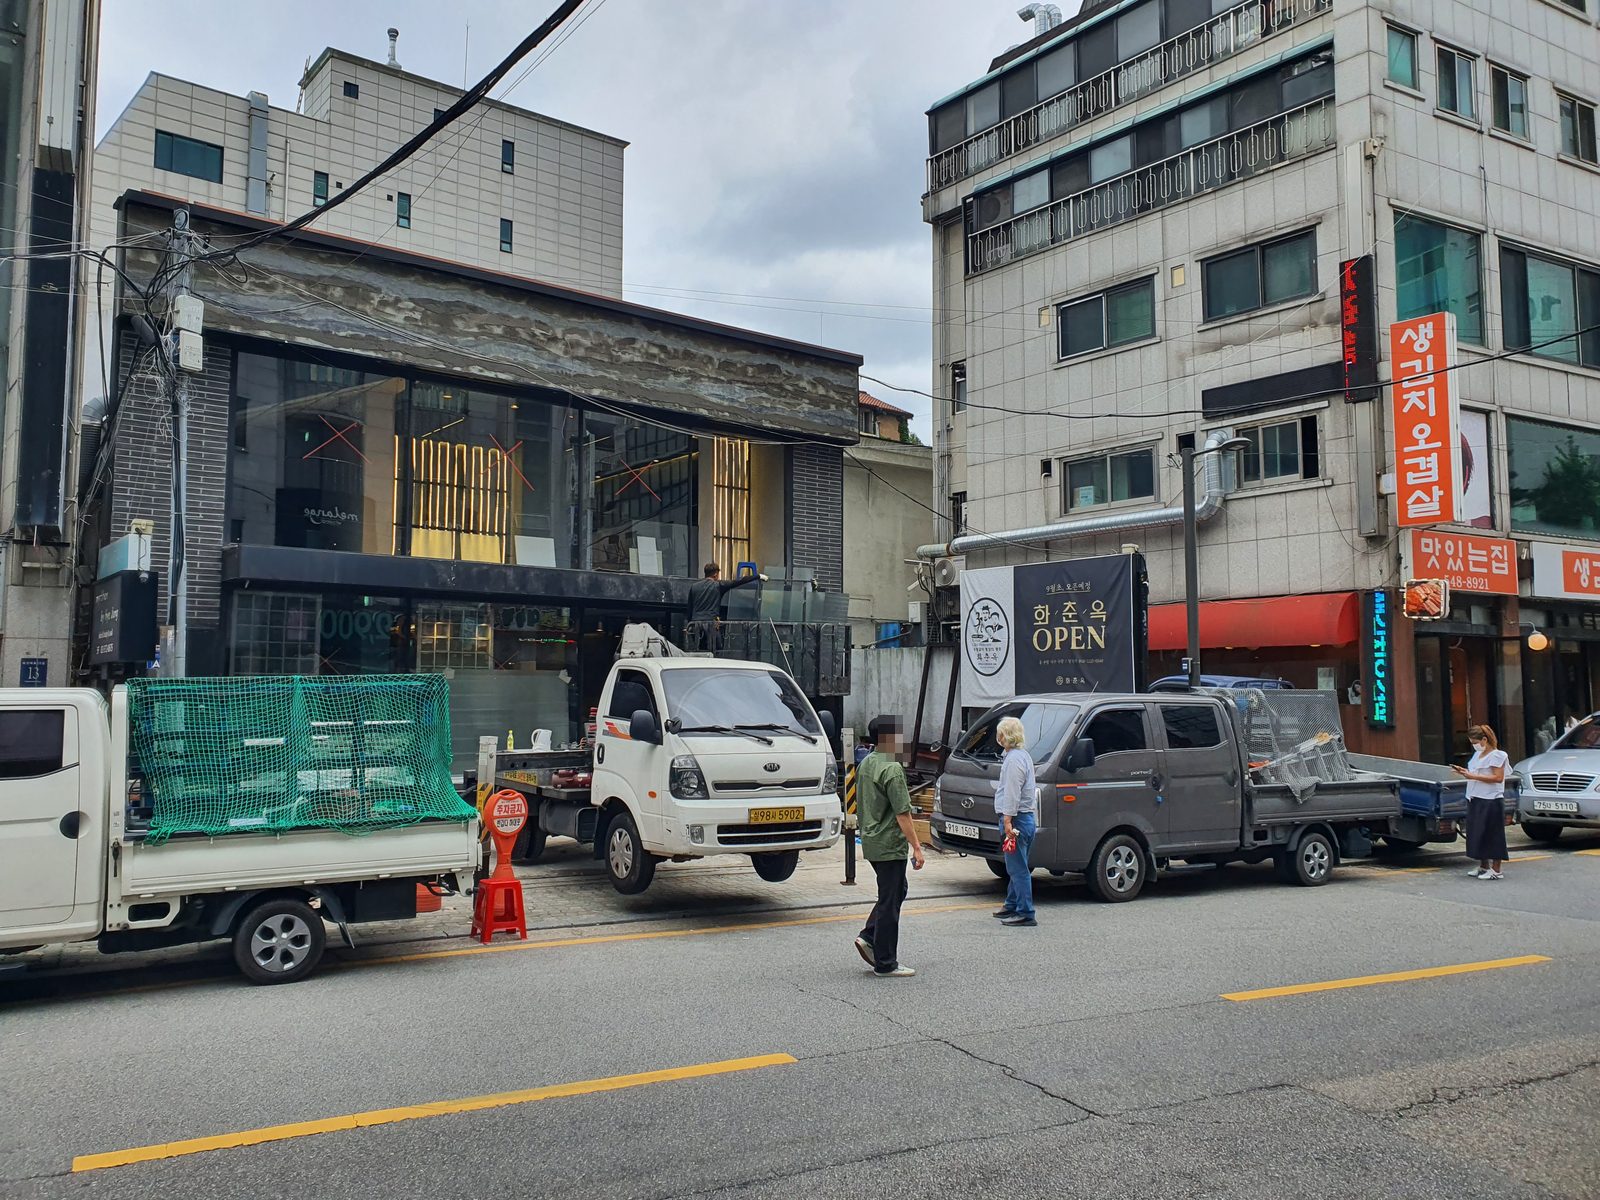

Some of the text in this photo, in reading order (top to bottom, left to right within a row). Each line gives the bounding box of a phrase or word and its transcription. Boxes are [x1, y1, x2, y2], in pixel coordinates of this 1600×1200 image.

[1399, 320, 1445, 518] 생김치오겹살
[1420, 537, 1509, 575] 맛있는집
[1065, 580, 1091, 592] 오픈예정
[1032, 625, 1106, 652] OPEN
[28, 666, 40, 680] 13
[1555, 802, 1574, 810] 5110
[778, 809, 801, 820] 5902
[961, 826, 976, 837] 1503
